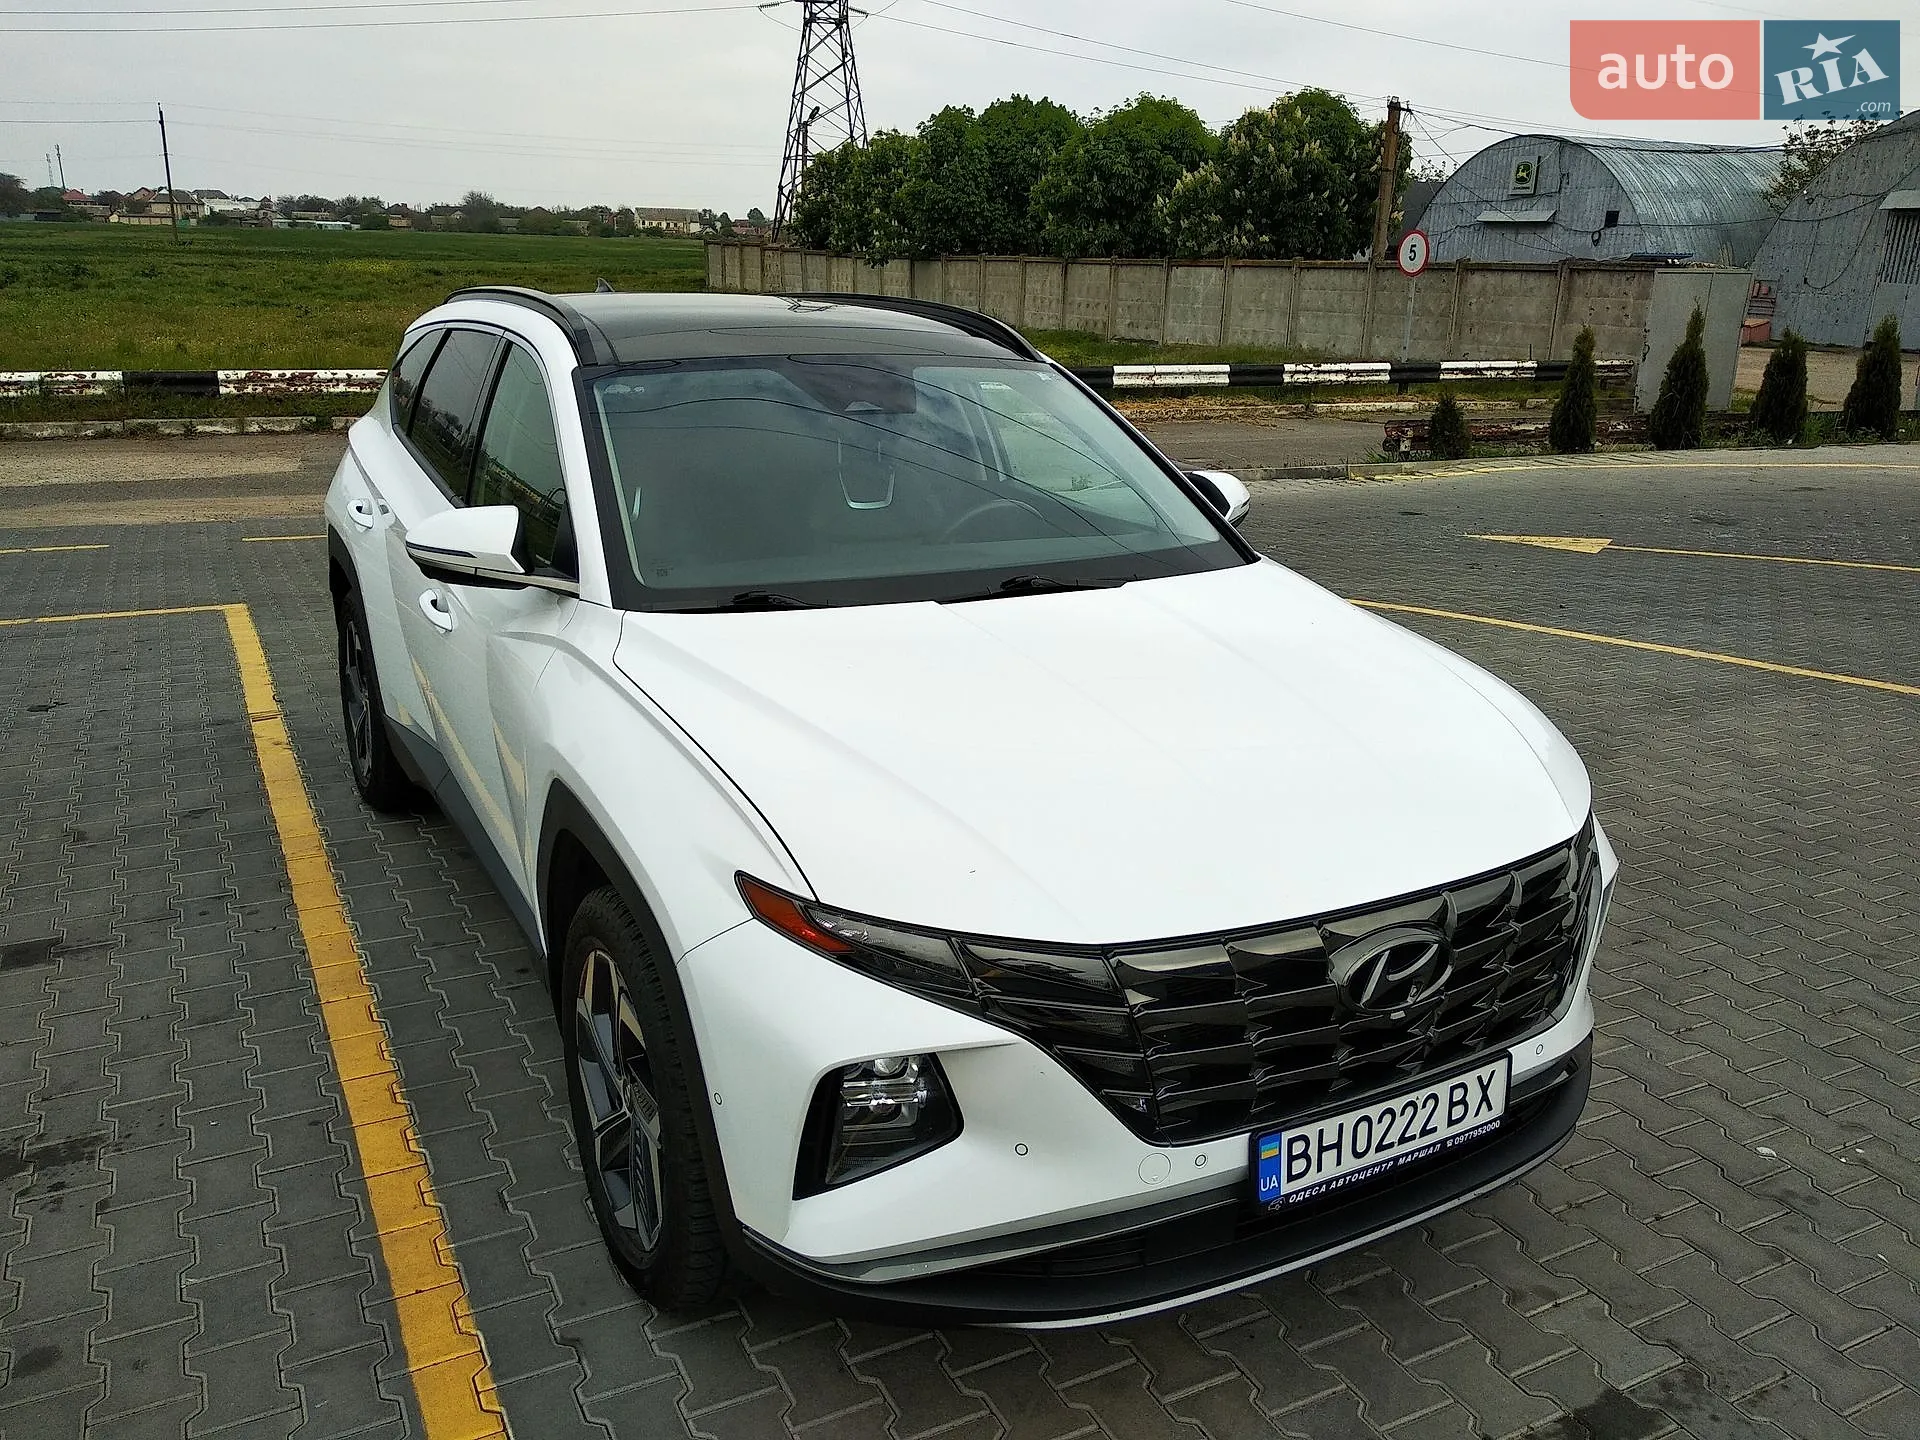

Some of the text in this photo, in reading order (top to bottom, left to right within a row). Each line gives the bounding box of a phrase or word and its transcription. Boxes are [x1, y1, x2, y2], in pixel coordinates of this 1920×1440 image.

[1408, 243, 1417, 262] 5
[1289, 1184, 1327, 1203] ОДЕСА
[1329, 1161, 1394, 1190] АВТОЦЕНТР
[1397, 1143, 1441, 1166] МАРШАЛ
[1260, 1174, 1279, 1192] UA
